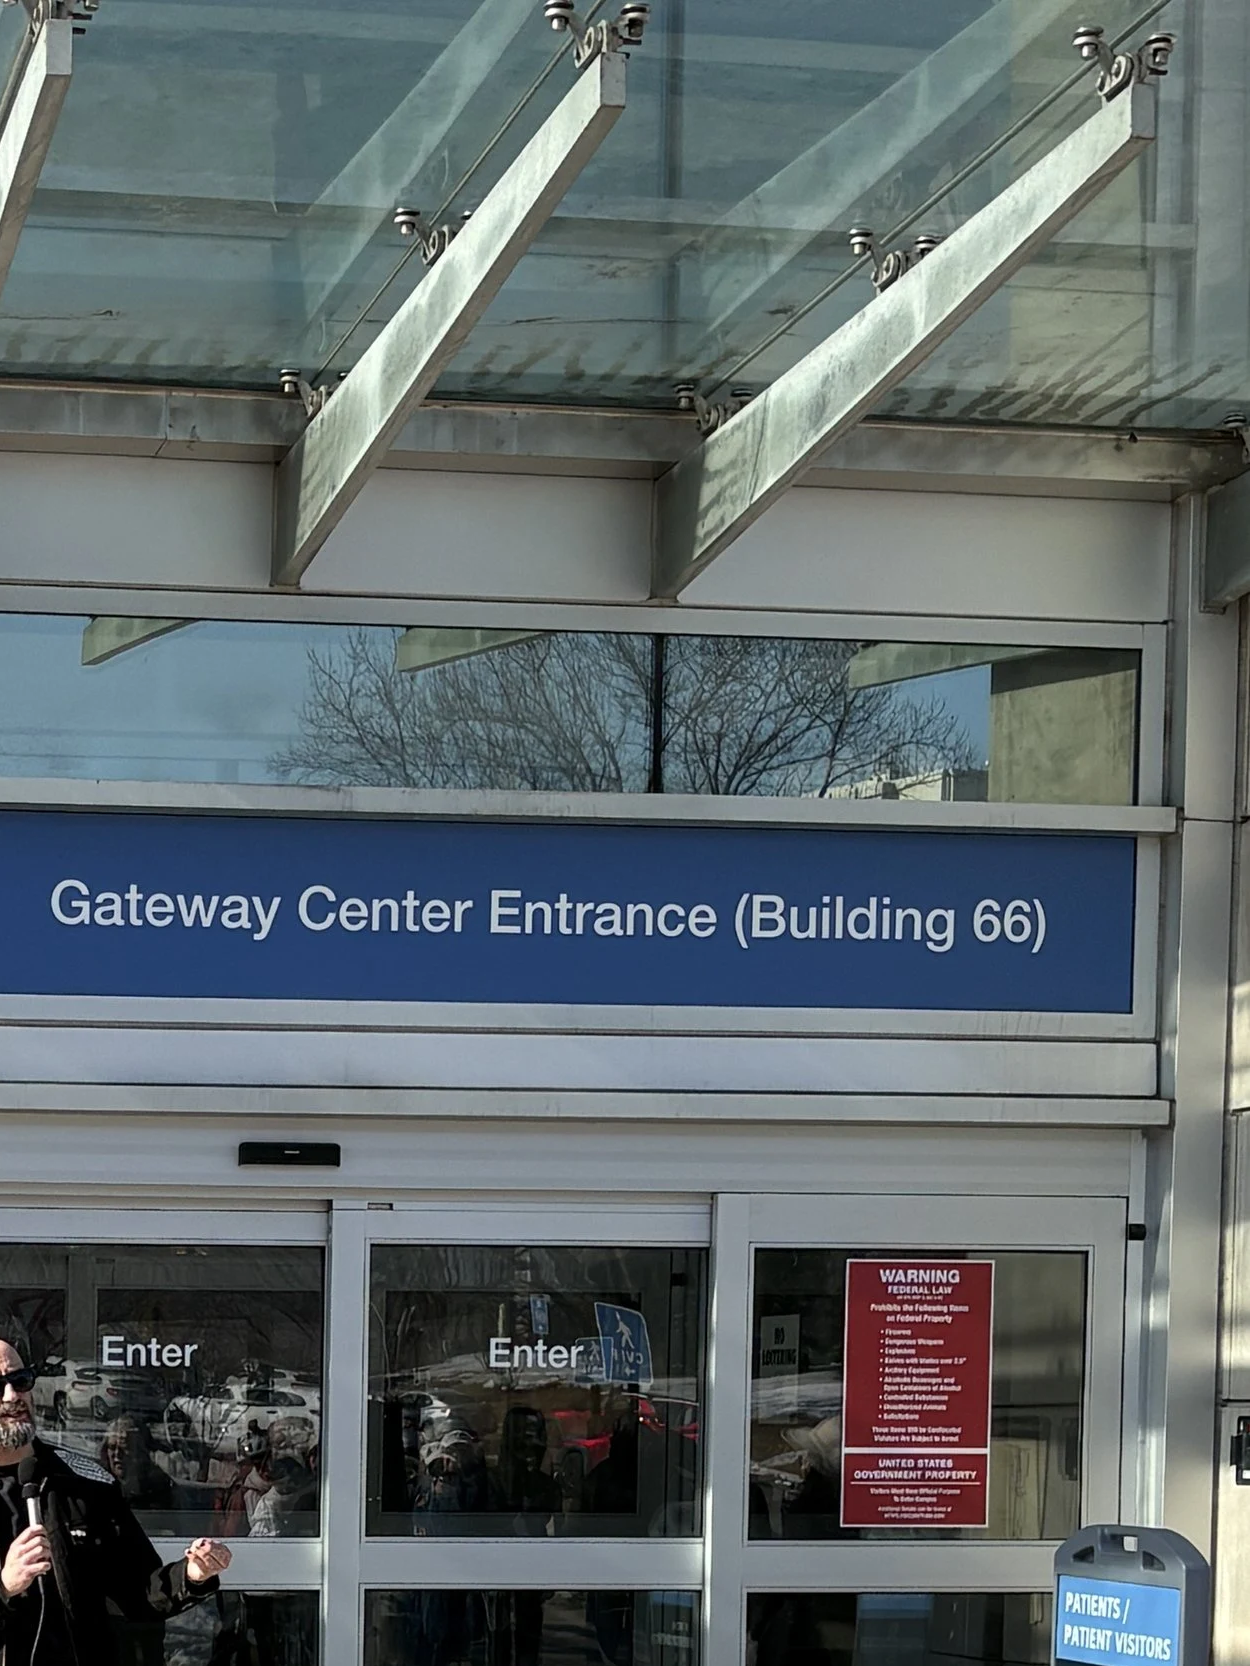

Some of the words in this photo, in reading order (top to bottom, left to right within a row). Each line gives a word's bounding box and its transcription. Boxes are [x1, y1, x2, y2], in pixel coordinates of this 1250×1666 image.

[49, 879, 280, 939] Gateway
[296, 885, 472, 934] Center
[490, 889, 717, 937] Entrance
[733, 892, 956, 953] (Building
[971, 897, 1047, 953] 66)
[879, 1269, 960, 1284] WARNING
[888, 1285, 929, 1294] FEDERAL
[932, 1286, 953, 1294] LAW
[102, 1336, 198, 1367] Enter
[490, 1337, 584, 1368] Enter
[1065, 1591, 1121, 1619] PATIENTS
[1064, 1624, 1113, 1651] PATIENT
[1114, 1631, 1171, 1661] VISITORS
